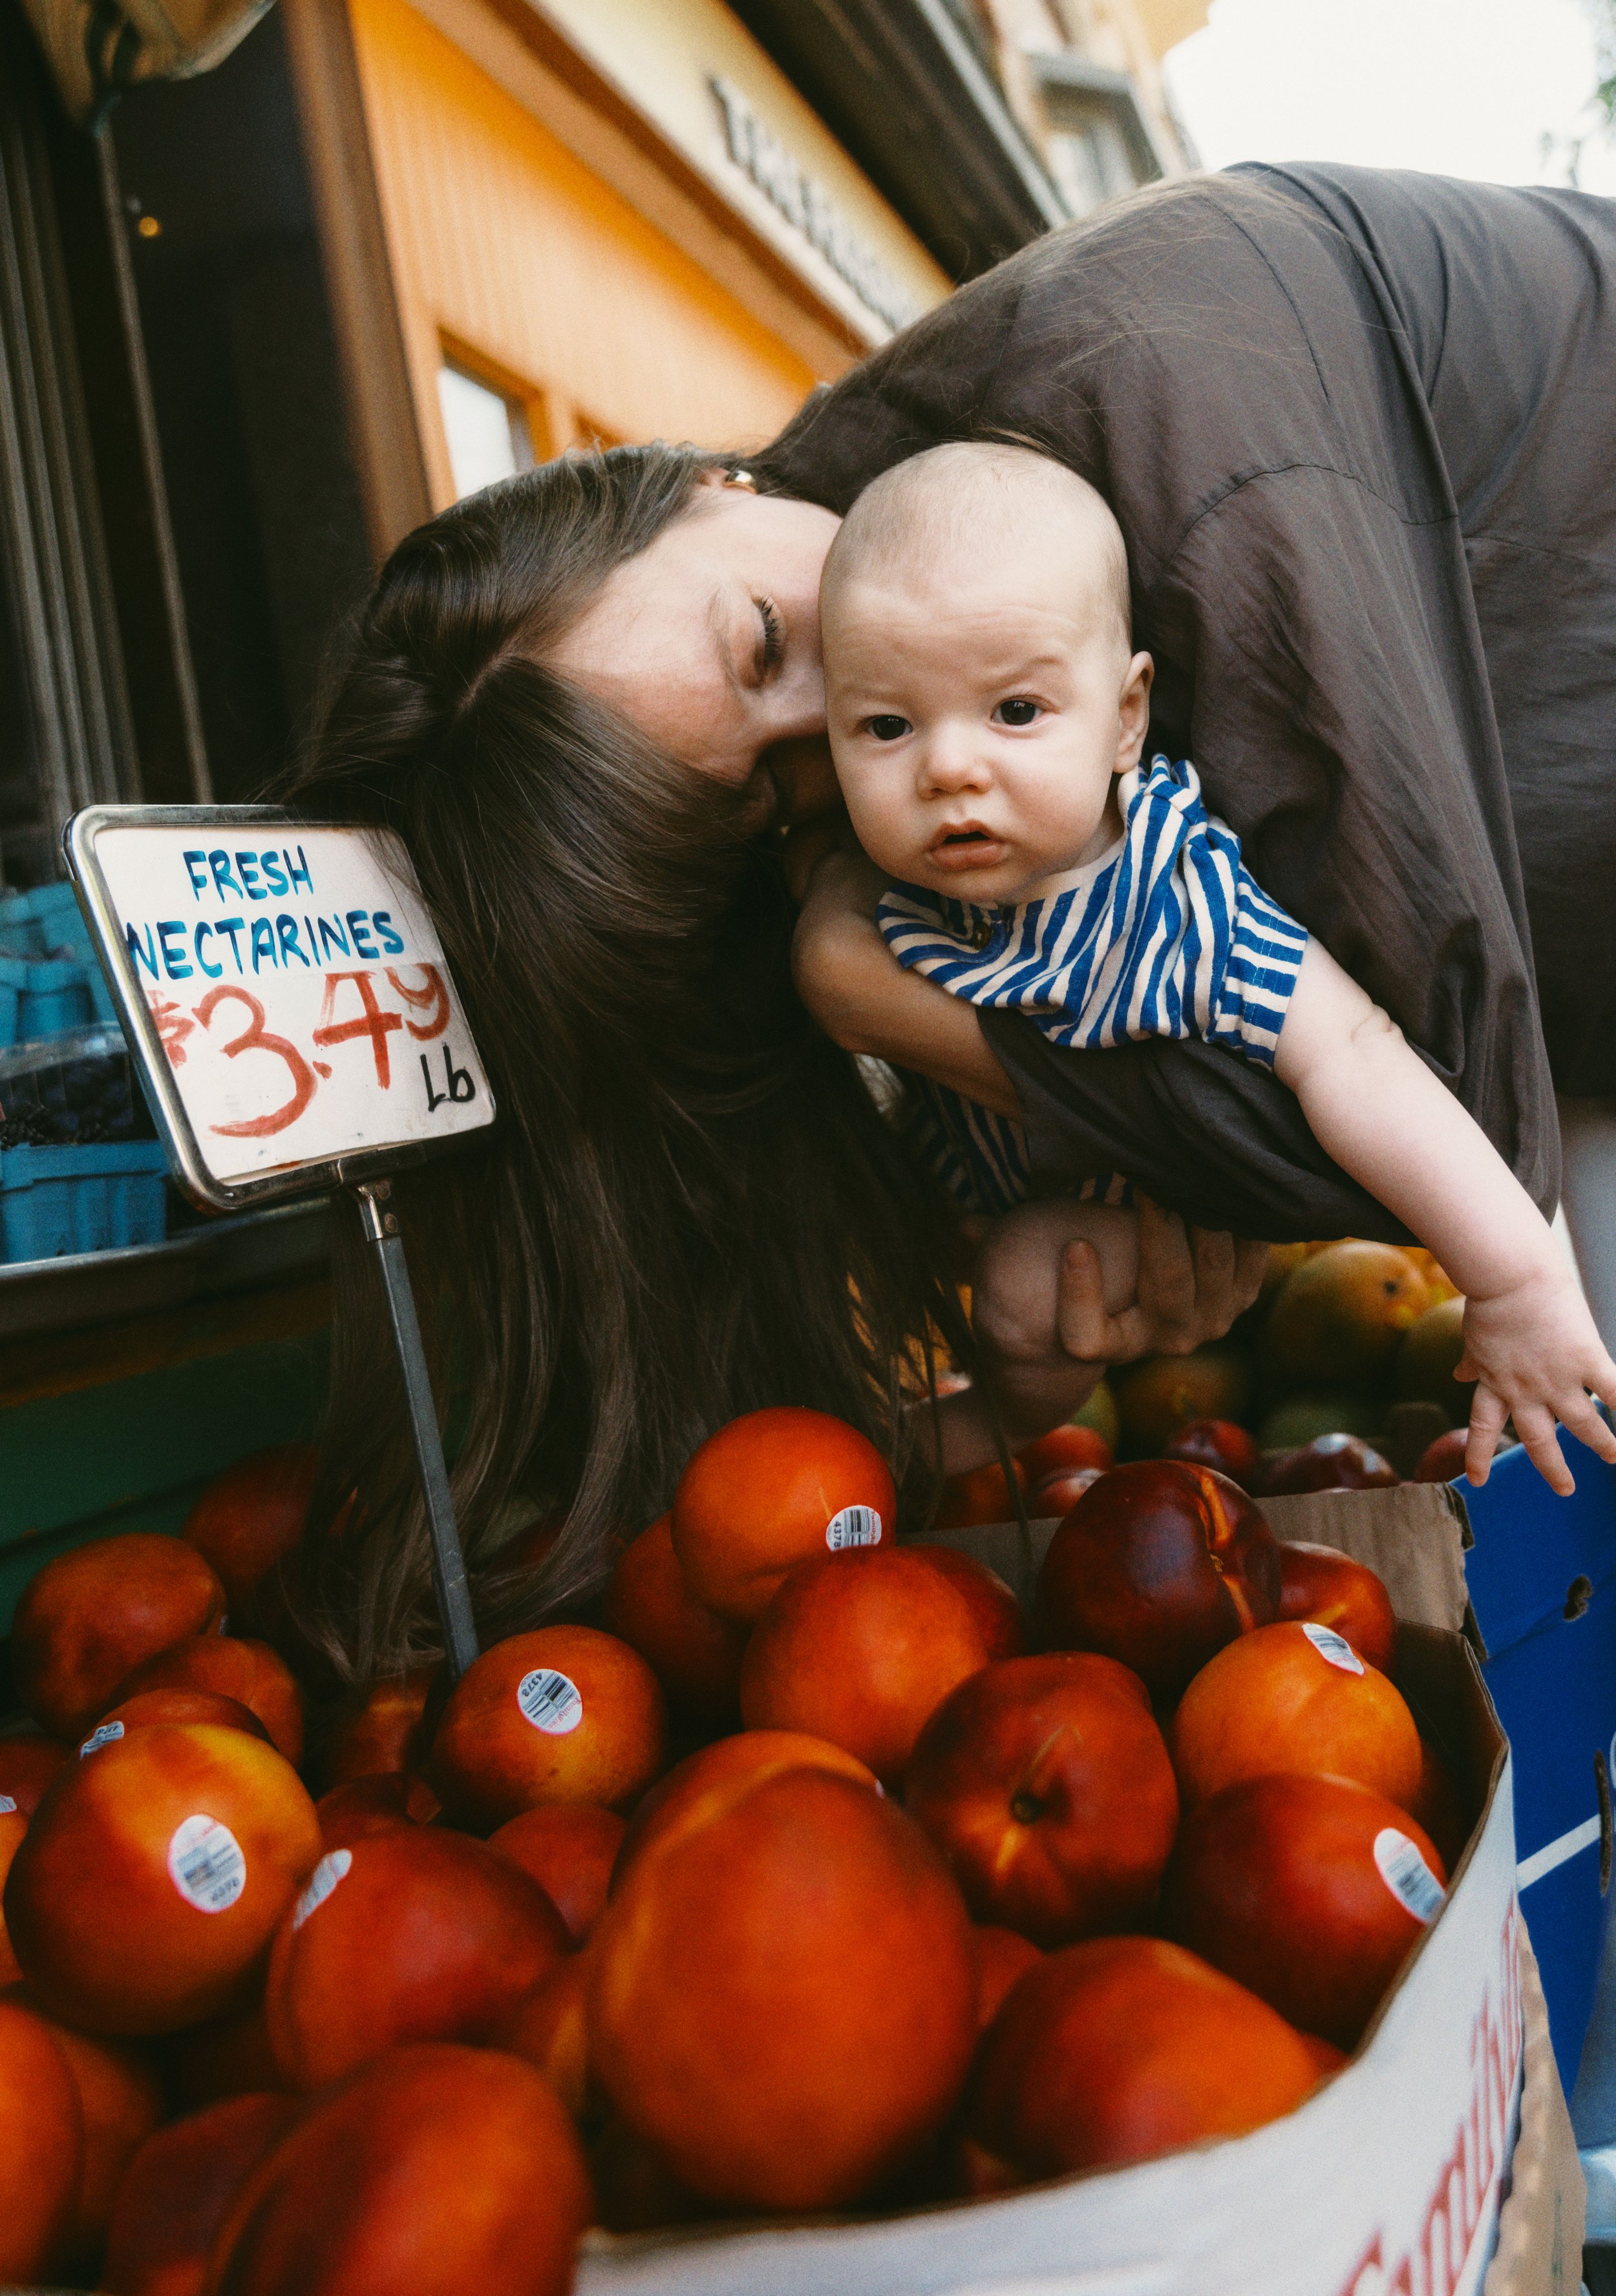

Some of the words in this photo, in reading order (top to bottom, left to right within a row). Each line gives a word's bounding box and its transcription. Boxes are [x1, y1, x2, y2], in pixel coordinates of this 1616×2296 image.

[183, 844, 314, 904] FRESH
[127, 910, 405, 981] NECTARINES
[420, 1041, 476, 1112] Lb
[521, 1672, 542, 1697] 4378
